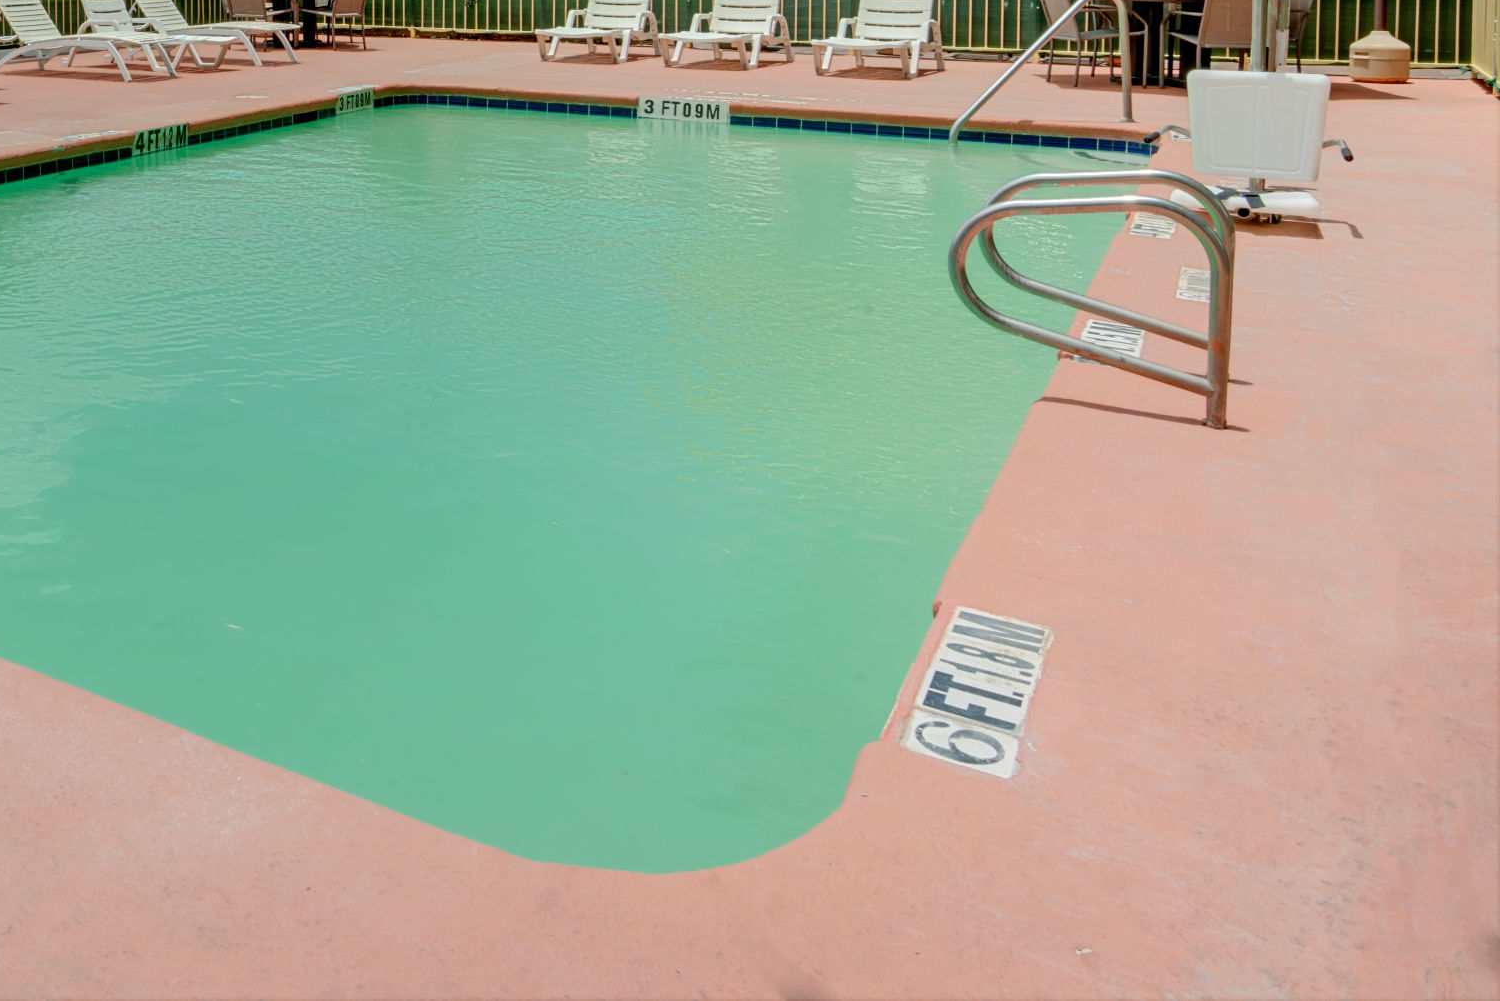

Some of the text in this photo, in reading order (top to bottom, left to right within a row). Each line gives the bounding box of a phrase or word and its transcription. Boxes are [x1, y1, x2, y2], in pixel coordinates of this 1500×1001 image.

[644, 99, 654, 114] 3
[135, 132, 145, 153] 4
[952, 610, 1046, 653] M
[915, 721, 1005, 765] 6
